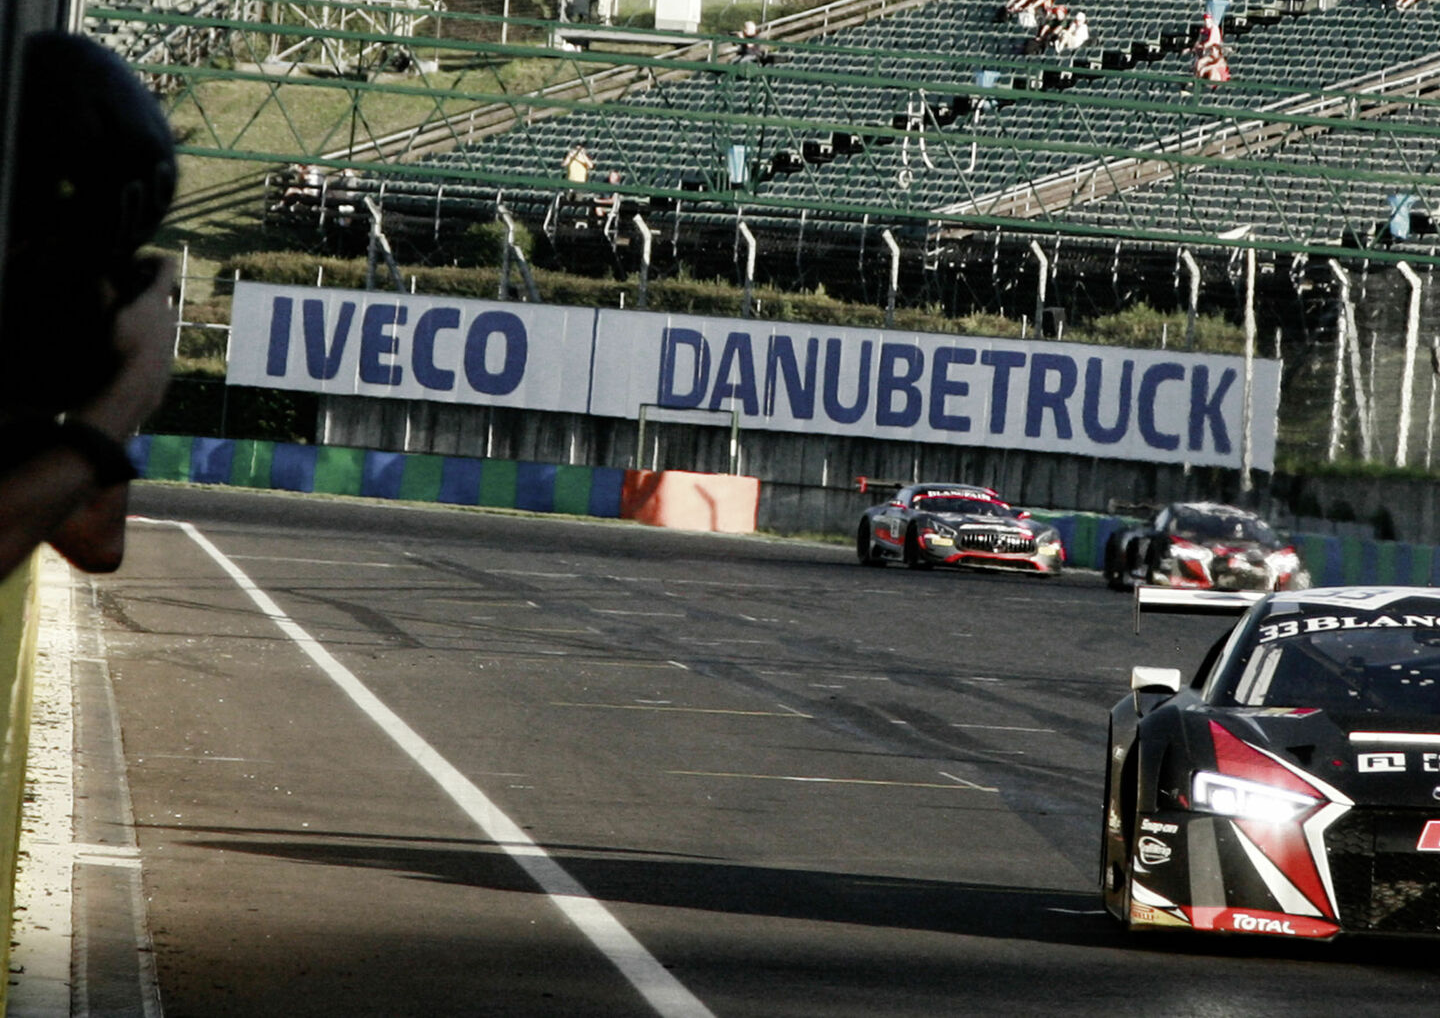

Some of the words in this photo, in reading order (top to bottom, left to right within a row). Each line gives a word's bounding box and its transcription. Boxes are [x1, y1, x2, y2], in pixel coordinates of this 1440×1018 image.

[266, 296, 528, 396] IVECO
[656, 327, 1238, 454] DANUBETRUCK
[1259, 620, 1299, 643] 33
[1233, 913, 1296, 935] TOTAL
